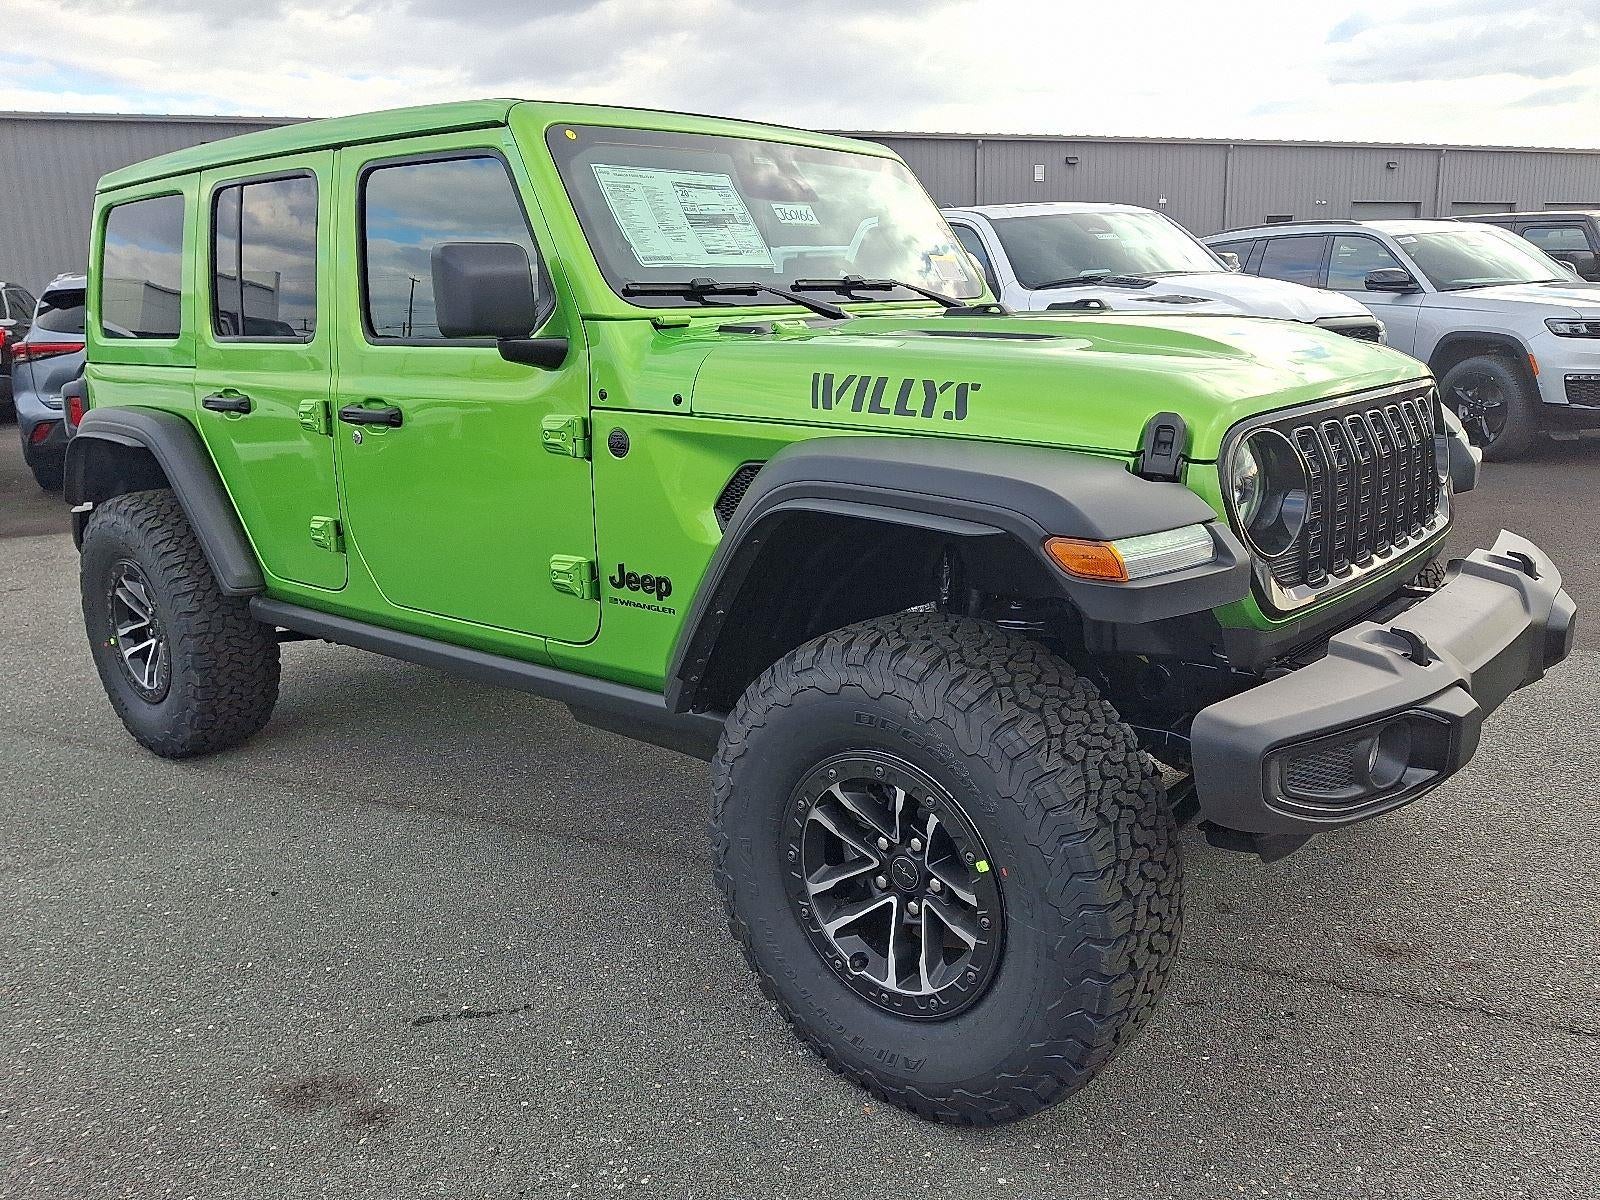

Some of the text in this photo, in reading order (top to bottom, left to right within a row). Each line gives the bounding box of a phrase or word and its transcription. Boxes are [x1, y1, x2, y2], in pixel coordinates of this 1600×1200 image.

[774, 207, 814, 222] J60166
[811, 372, 982, 421] WILLYS
[608, 562, 673, 602] Jeep
[618, 598, 676, 615] WRANGLER
